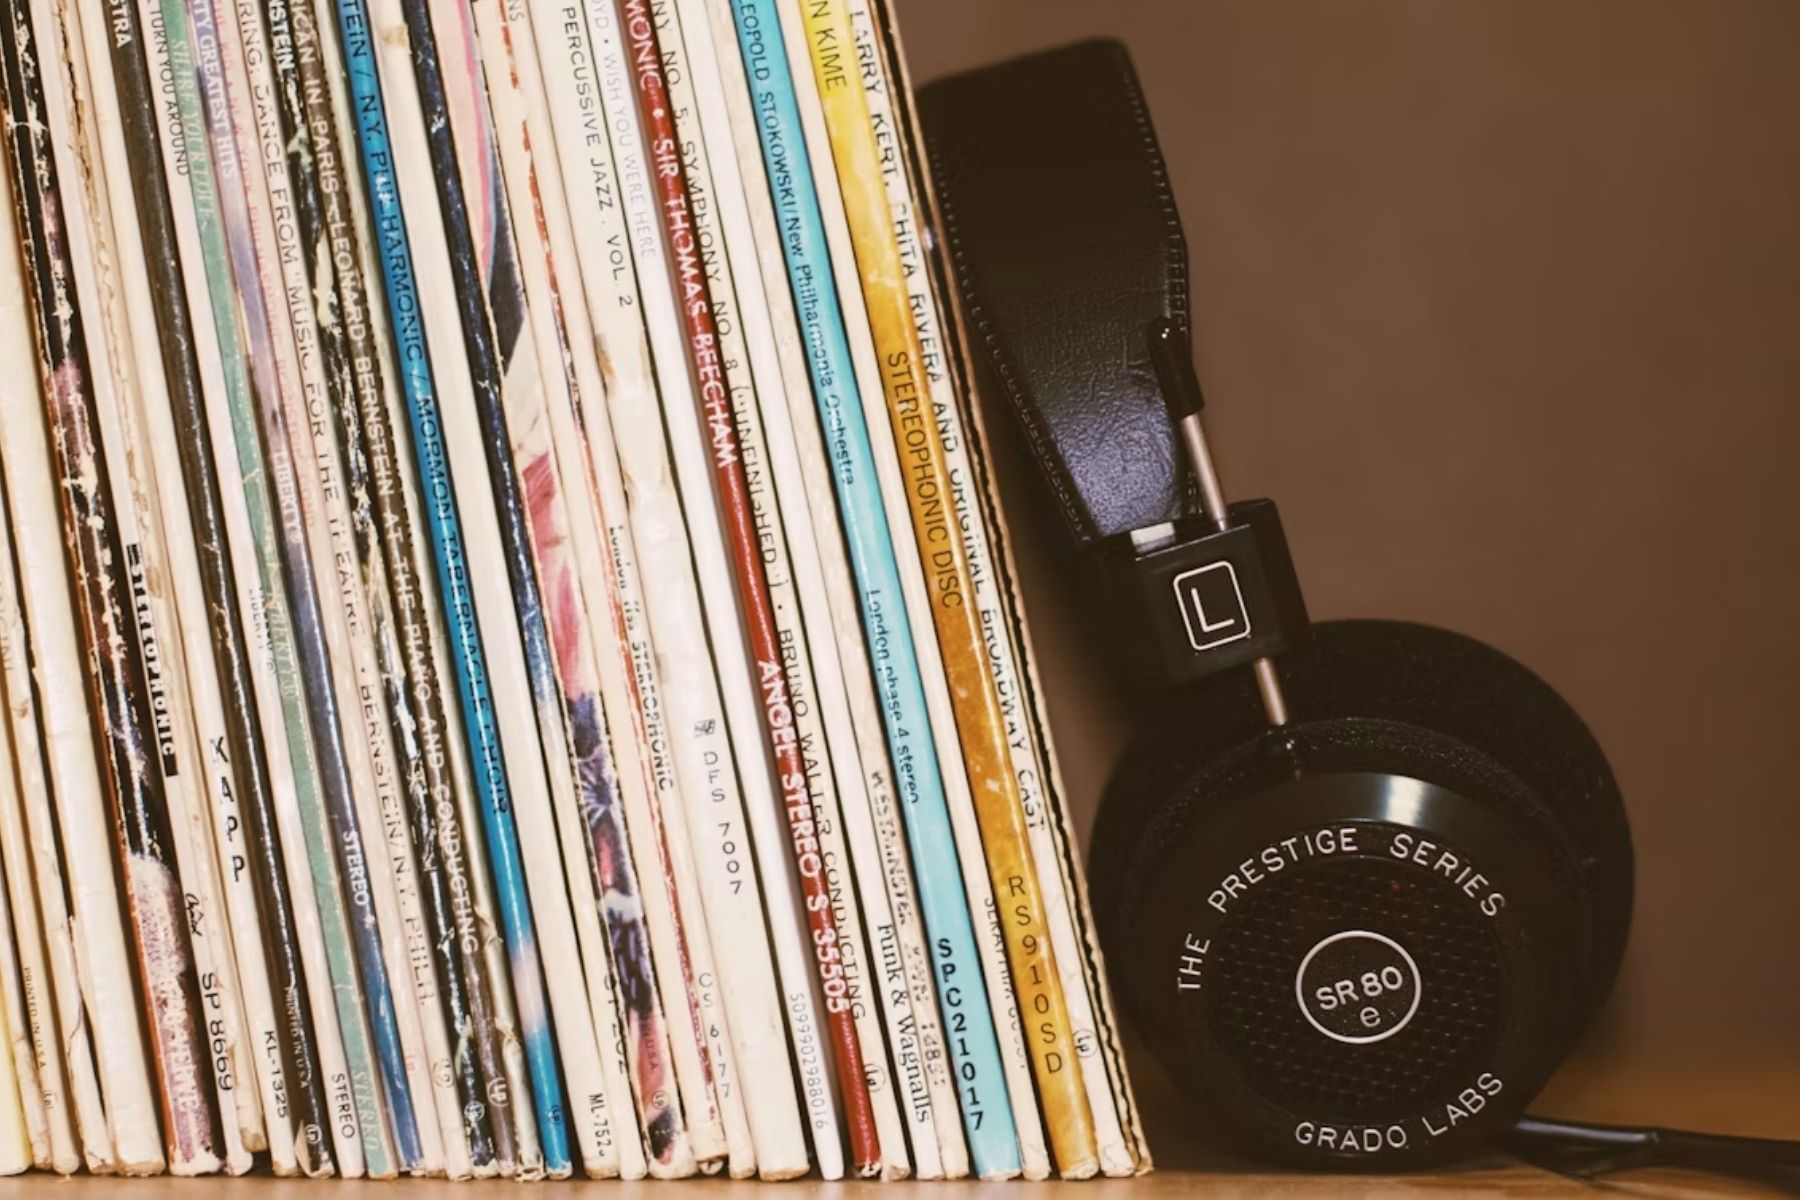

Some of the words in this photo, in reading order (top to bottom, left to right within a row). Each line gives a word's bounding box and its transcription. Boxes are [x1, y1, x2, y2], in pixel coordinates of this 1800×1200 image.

[148, 8, 168, 54] TURN
[342, 0, 367, 57] TEIN
[813, 27, 847, 91] KIME
[157, 60, 175, 94] YOU
[197, 34, 231, 131] GREATEST
[215, 135, 239, 178] HITS
[304, 77, 323, 104] IN
[602, 53, 623, 100] WISH
[164, 99, 189, 177] AROUND
[359, 94, 382, 141] N.Y.
[560, 5, 601, 146] PERCUSSIVE
[618, 294, 633, 307] 2
[612, 105, 633, 147] YOU
[621, 152, 644, 202] WERE
[651, 136, 679, 179] SIR
[369, 151, 423, 362] PHILHARMONIC
[632, 210, 655, 259] HERE
[663, 193, 708, 317] THOMAS
[252, 83, 283, 176] DANCE
[271, 188, 298, 263] FROM
[304, 382, 327, 437] FOR
[316, 449, 339, 502] THE
[691, 331, 739, 468] BEECHAM
[794, 264, 837, 387] Philharmonia
[823, 393, 858, 487] Orchestra
[354, 356, 394, 496] BERNSTEIN
[415, 396, 453, 521] MORMON
[848, 10, 882, 97] LARRY
[908, 292, 943, 384] RIVERA
[933, 400, 959, 453] AND
[948, 466, 990, 594] ORIGINAL
[978, 607, 1027, 753] BROADWAY
[1015, 768, 1045, 832] CAST
[886, 350, 949, 543] STEREOPHONIC
[931, 550, 964, 609] DISC
[382, 510, 403, 544] AT
[391, 557, 415, 609] THE
[679, 139, 723, 284] SYMPHONY
[723, 357, 739, 370] 8
[777, 627, 808, 718] BRUNO
[798, 732, 832, 836] WALTER
[821, 850, 866, 1020] CONDUCTING
[1190, 587, 1235, 632] L
[440, 532, 488, 713] TABERNACLE
[864, 588, 894, 659] London
[402, 623, 432, 702] PIANO
[877, 664, 907, 722] phase
[419, 714, 444, 770] AND
[629, 640, 674, 791] STEREOPHONIC
[756, 657, 798, 758] ANGEL
[894, 725, 910, 739] 4
[476, 724, 508, 815] CHOIR
[895, 743, 922, 804] stereo
[210, 736, 247, 883] KAPP
[779, 770, 823, 878] STEREO
[341, 829, 370, 907] STEREO
[432, 783, 479, 954] CONDUCTING
[715, 821, 746, 895] 7007
[804, 891, 830, 913] S
[1177, 932, 1211, 993] THE
[1207, 827, 1359, 914] PRESTIGE
[1389, 833, 1506, 917] SERIES
[199, 971, 221, 1010] SP
[811, 925, 851, 1014] 35505
[874, 922, 905, 983] Funk
[890, 987, 910, 1007] &
[1359, 1005, 1381, 1028] e
[208, 1018, 234, 1092] 8669
[261, 1030, 290, 1119] KL-1325
[790, 991, 828, 1129] 5099902988016
[892, 1014, 933, 1124] Wagnalls
[330, 1072, 356, 1139] STEREO
[1295, 1121, 1408, 1152] GRADO
[1421, 1072, 1503, 1137] LABS
